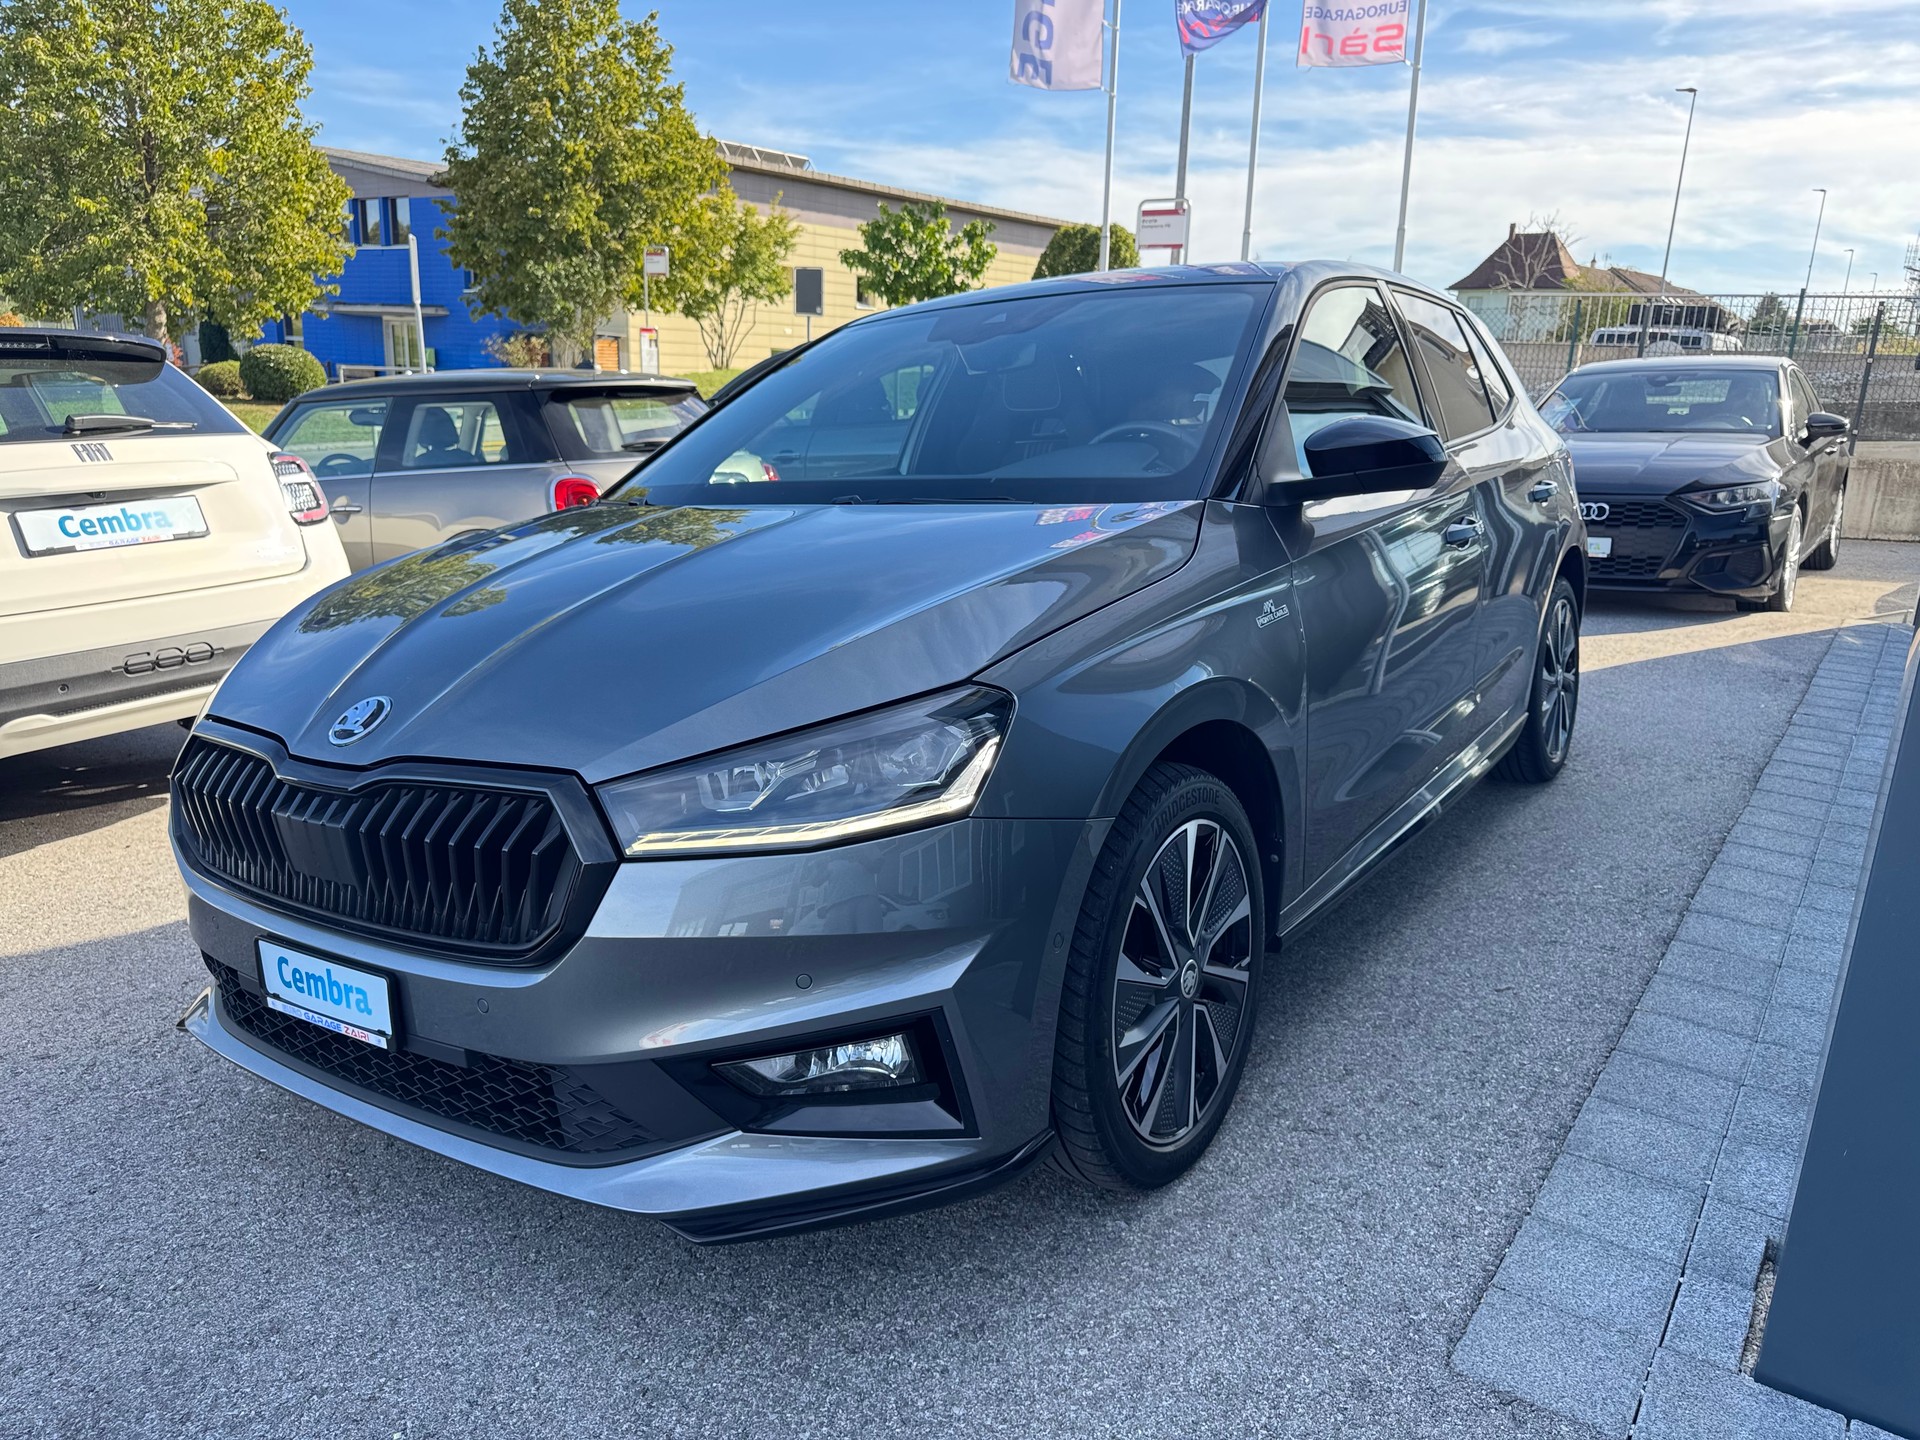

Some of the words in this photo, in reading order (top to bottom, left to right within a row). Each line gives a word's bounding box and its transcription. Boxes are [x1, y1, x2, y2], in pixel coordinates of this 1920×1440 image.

[57, 507, 172, 538] Cembra
[1151, 786, 1220, 836] BRIDGESTONE
[277, 956, 372, 1016] Cembra
[304, 1008, 342, 1032] GARAGE
[343, 1026, 370, 1042] ZAIRI
